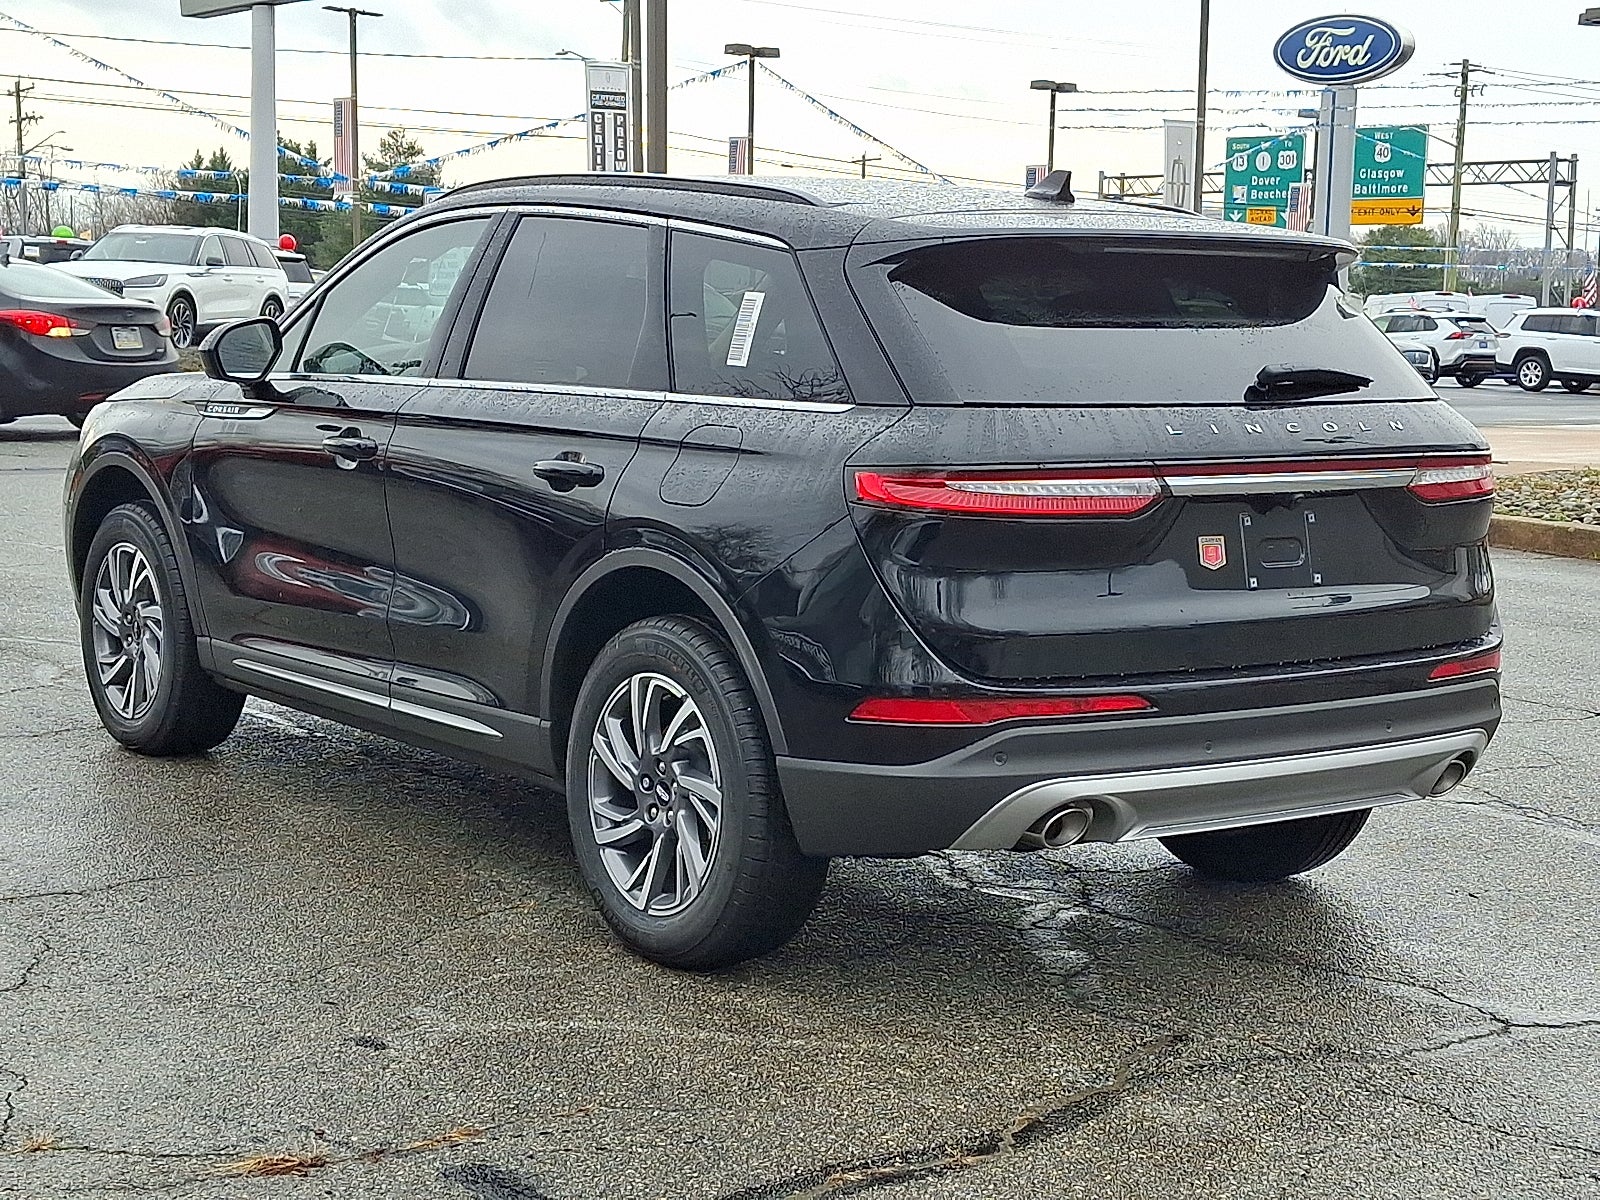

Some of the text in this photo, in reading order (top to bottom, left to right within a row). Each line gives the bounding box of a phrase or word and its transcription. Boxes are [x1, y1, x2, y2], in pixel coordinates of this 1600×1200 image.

[1297, 27, 1375, 69] Ford
[1374, 132, 1393, 140] WEST
[1377, 147, 1390, 158] 40
[1235, 155, 1245, 167] 13
[1279, 154, 1295, 165] 301
[1251, 175, 1281, 186] Dover
[1360, 168, 1404, 182] Glasgow
[1354, 183, 1408, 194] Baltimore
[1379, 207, 1401, 216] ONLY
[207, 405, 240, 414] CORSAIR
[1165, 419, 1405, 436] LINCOLN
